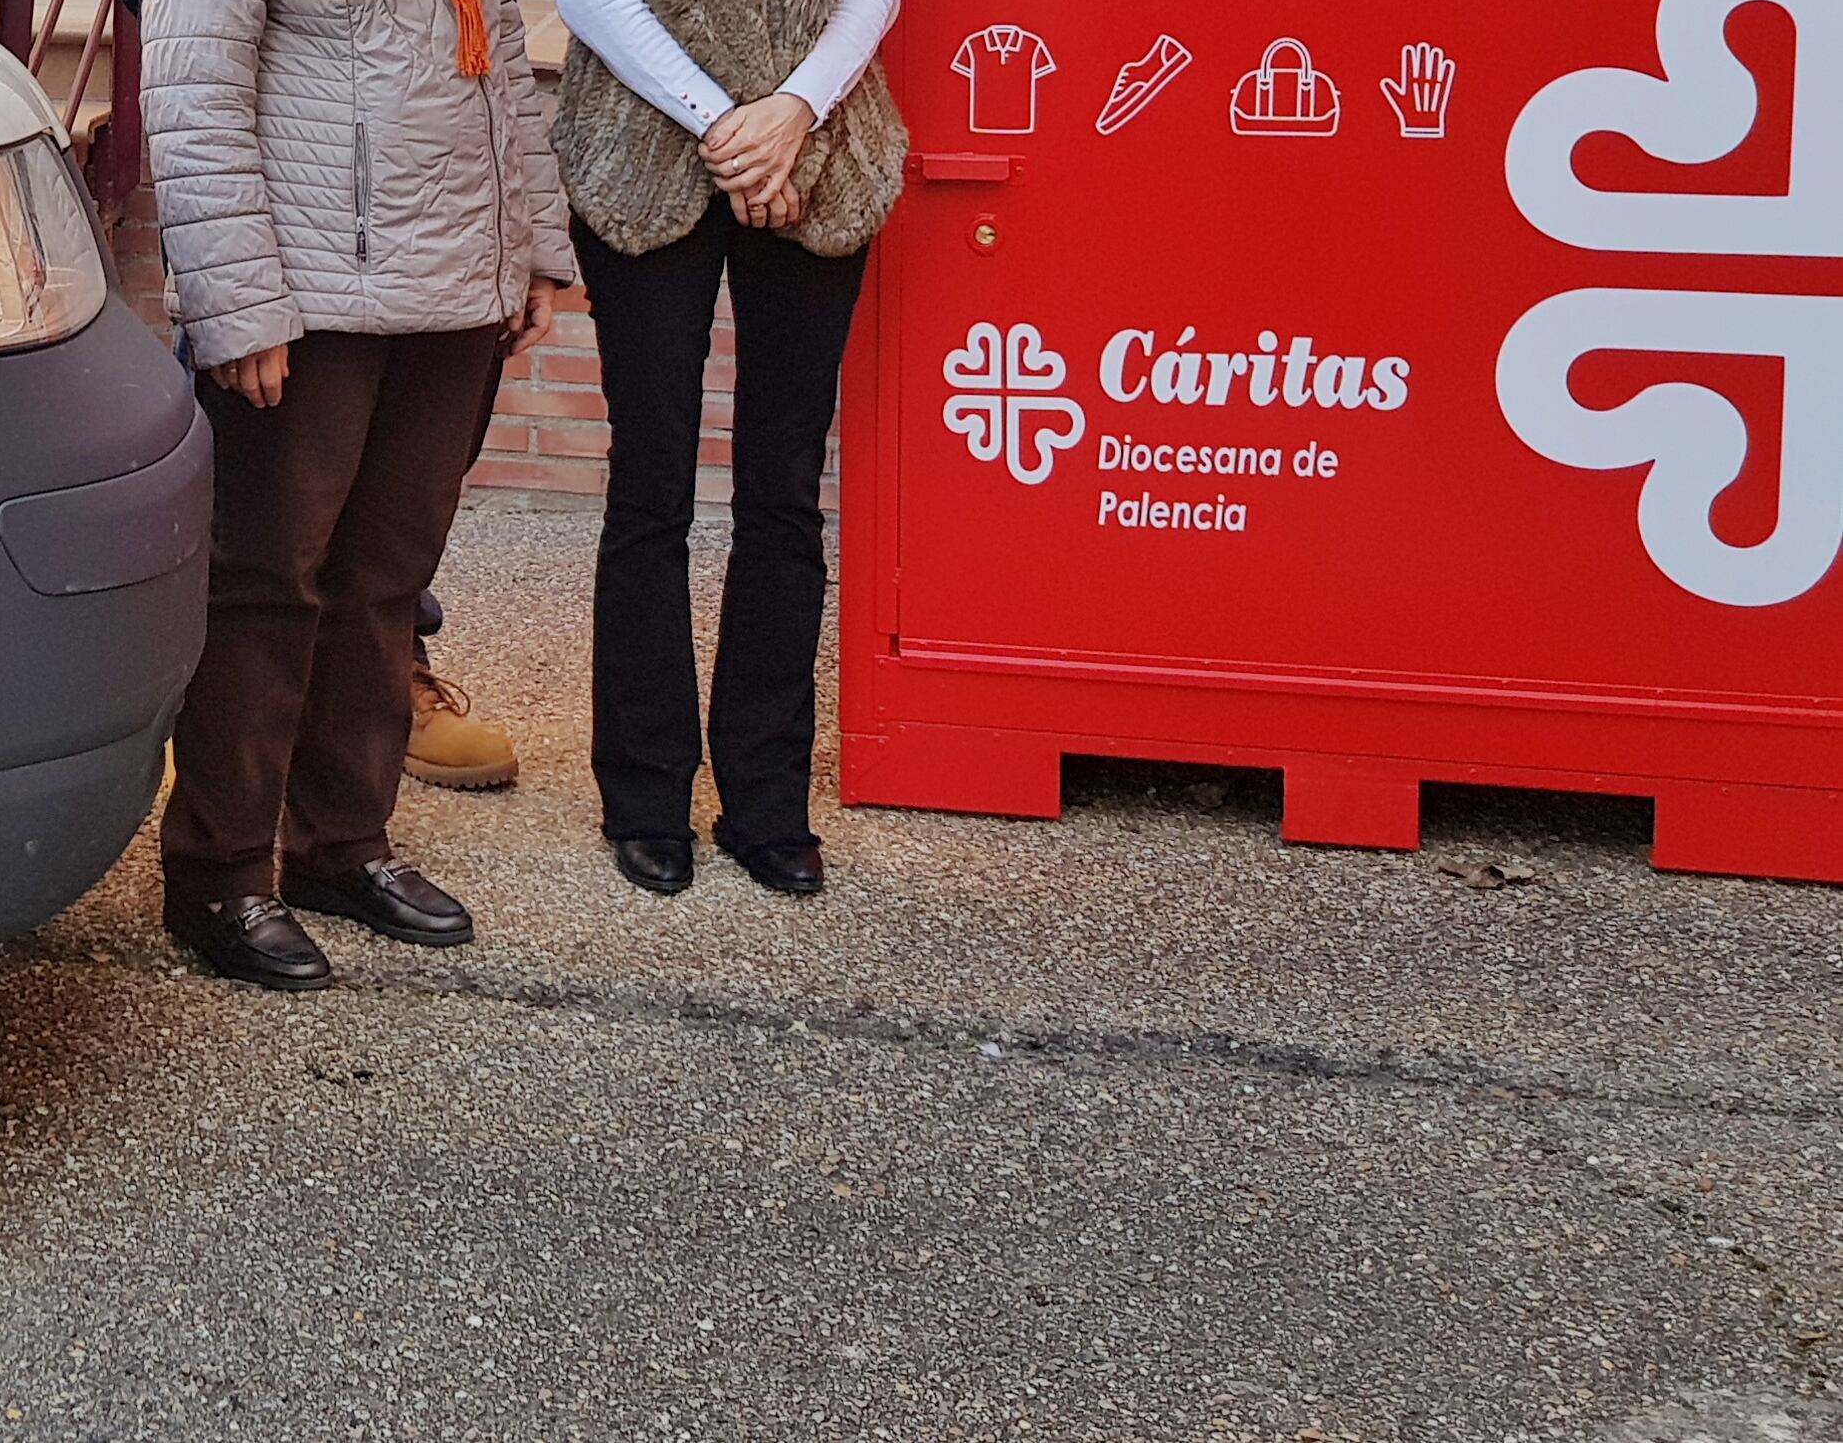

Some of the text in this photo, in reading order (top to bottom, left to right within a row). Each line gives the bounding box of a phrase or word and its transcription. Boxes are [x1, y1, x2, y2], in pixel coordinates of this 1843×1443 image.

[1099, 325, 1410, 411] Cáritas
[1098, 434, 1339, 478] Diocesana de
[1098, 491, 1247, 531] Palencia
